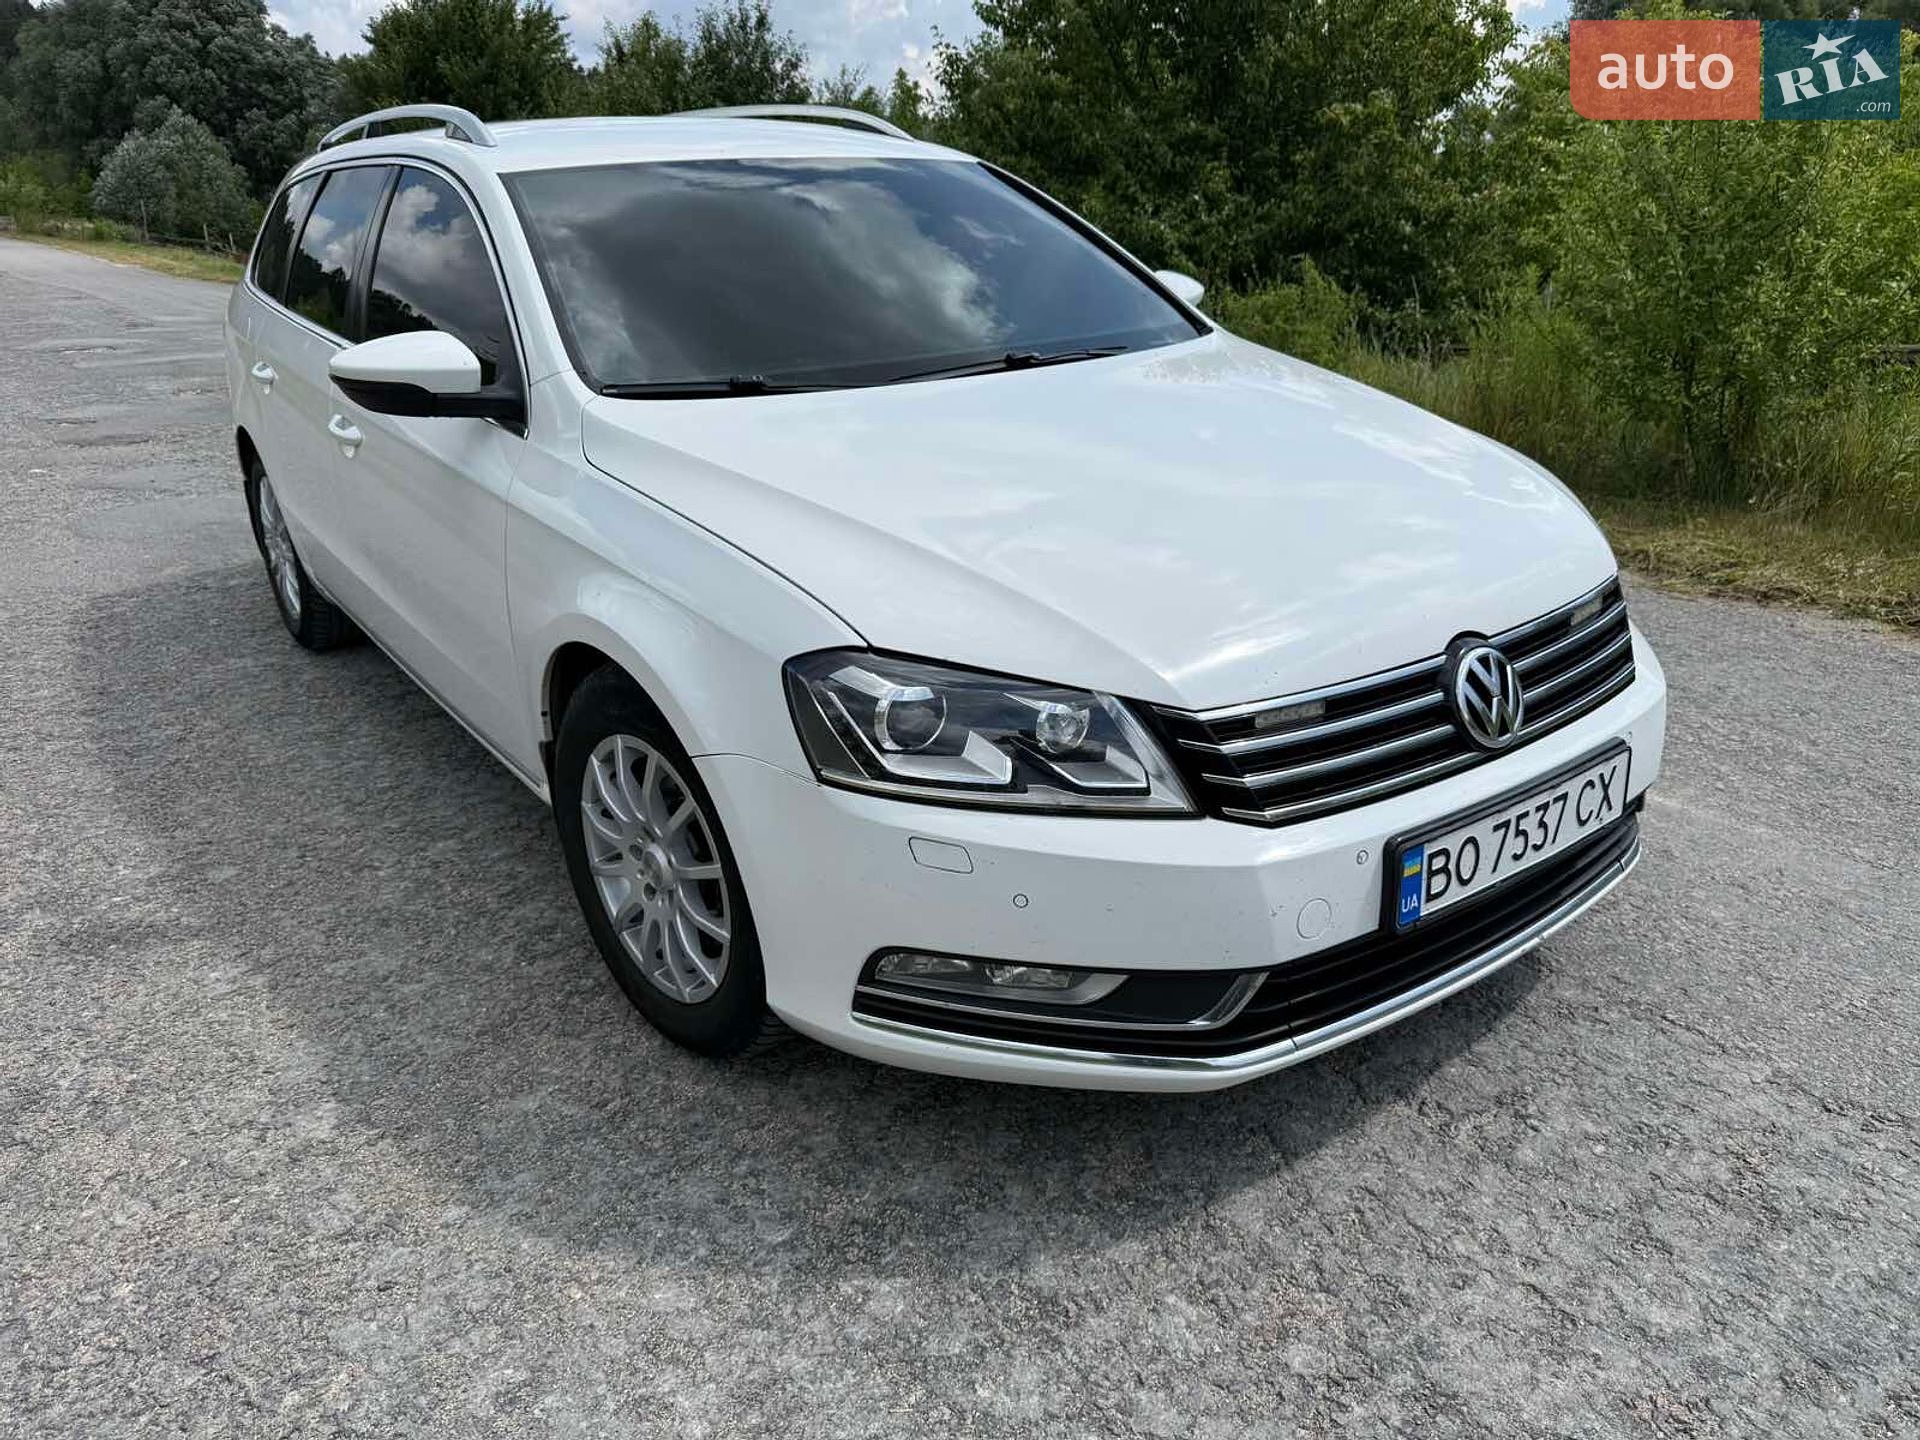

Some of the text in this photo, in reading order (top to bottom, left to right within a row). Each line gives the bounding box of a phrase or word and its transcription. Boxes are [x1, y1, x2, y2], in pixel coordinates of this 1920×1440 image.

[1458, 648, 1520, 745] VW
[1426, 765, 1618, 903] BO 7537 CX
[1401, 896, 1419, 913] UA
